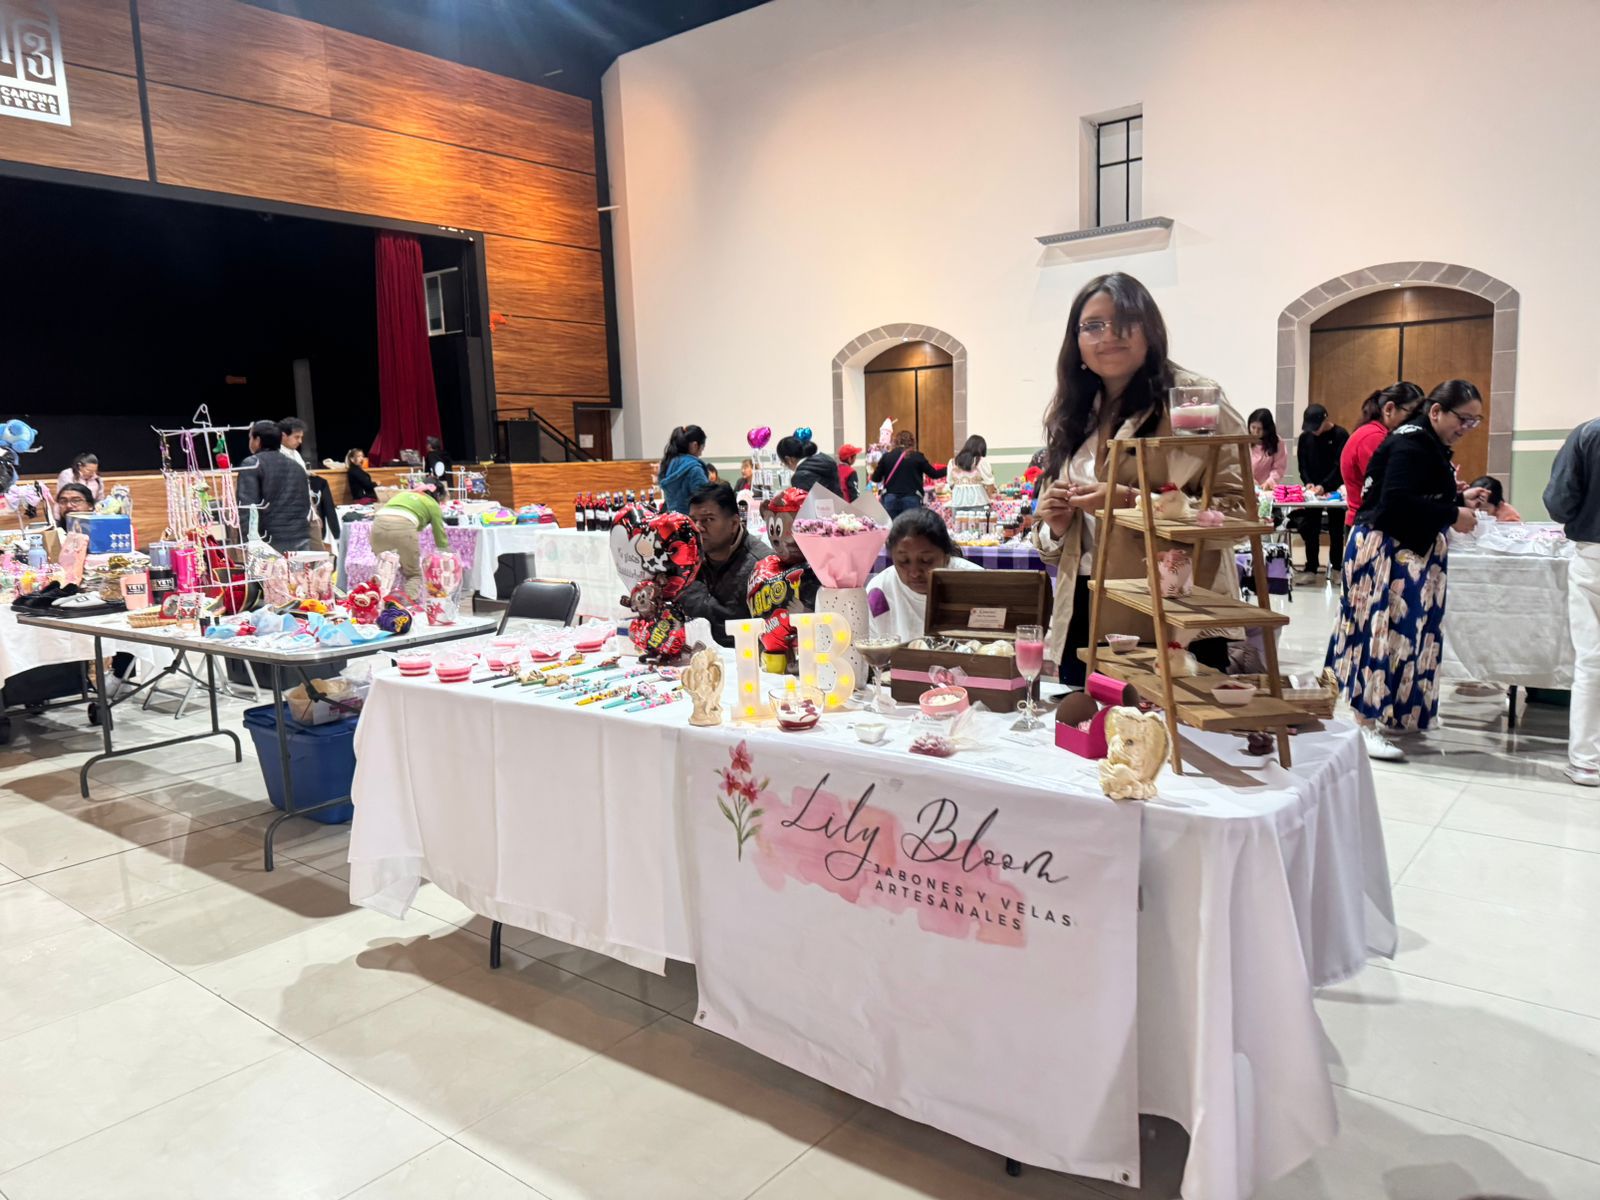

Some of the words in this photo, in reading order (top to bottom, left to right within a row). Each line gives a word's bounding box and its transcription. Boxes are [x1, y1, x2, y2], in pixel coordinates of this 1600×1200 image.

[0, 86, 57, 105] CANCHA
[1, 95, 58, 114] TRECE
[781, 773, 880, 881] Lily
[901, 797, 1069, 884] Bloom
[873, 863, 964, 898] JABONES
[977, 890, 987, 904] Y
[1000, 897, 1072, 928] VELAS
[875, 880, 1022, 931] ARTESANALES
